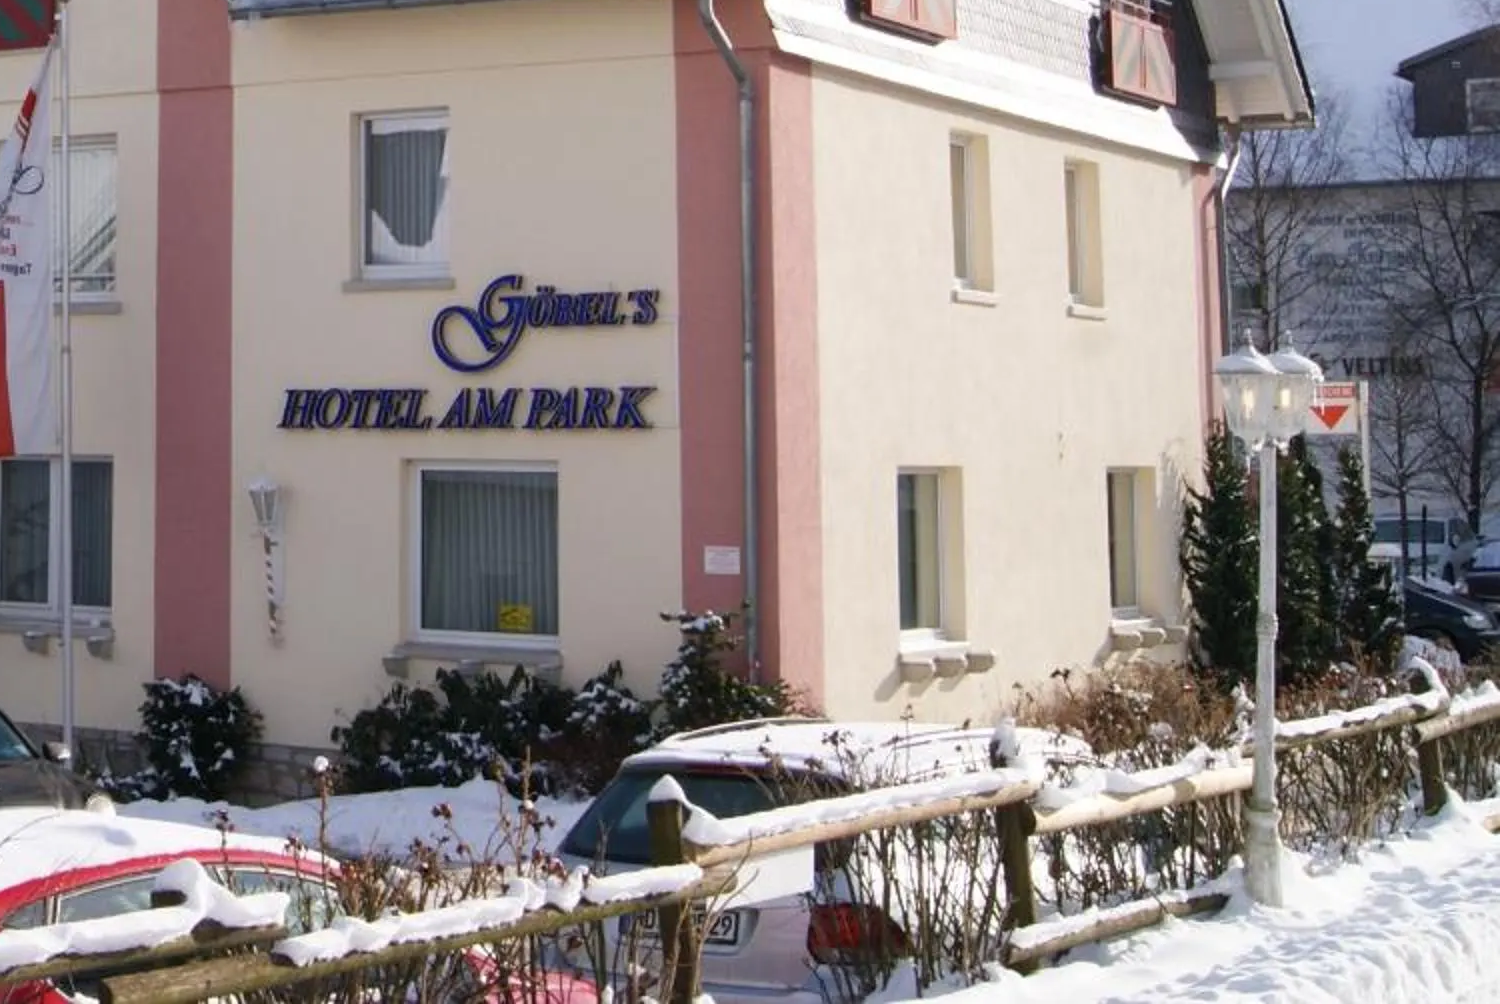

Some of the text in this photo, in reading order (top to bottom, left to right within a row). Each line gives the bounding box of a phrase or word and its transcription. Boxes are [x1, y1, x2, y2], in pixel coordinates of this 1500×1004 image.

[277, 386, 658, 430] HOTEL AM PARK
